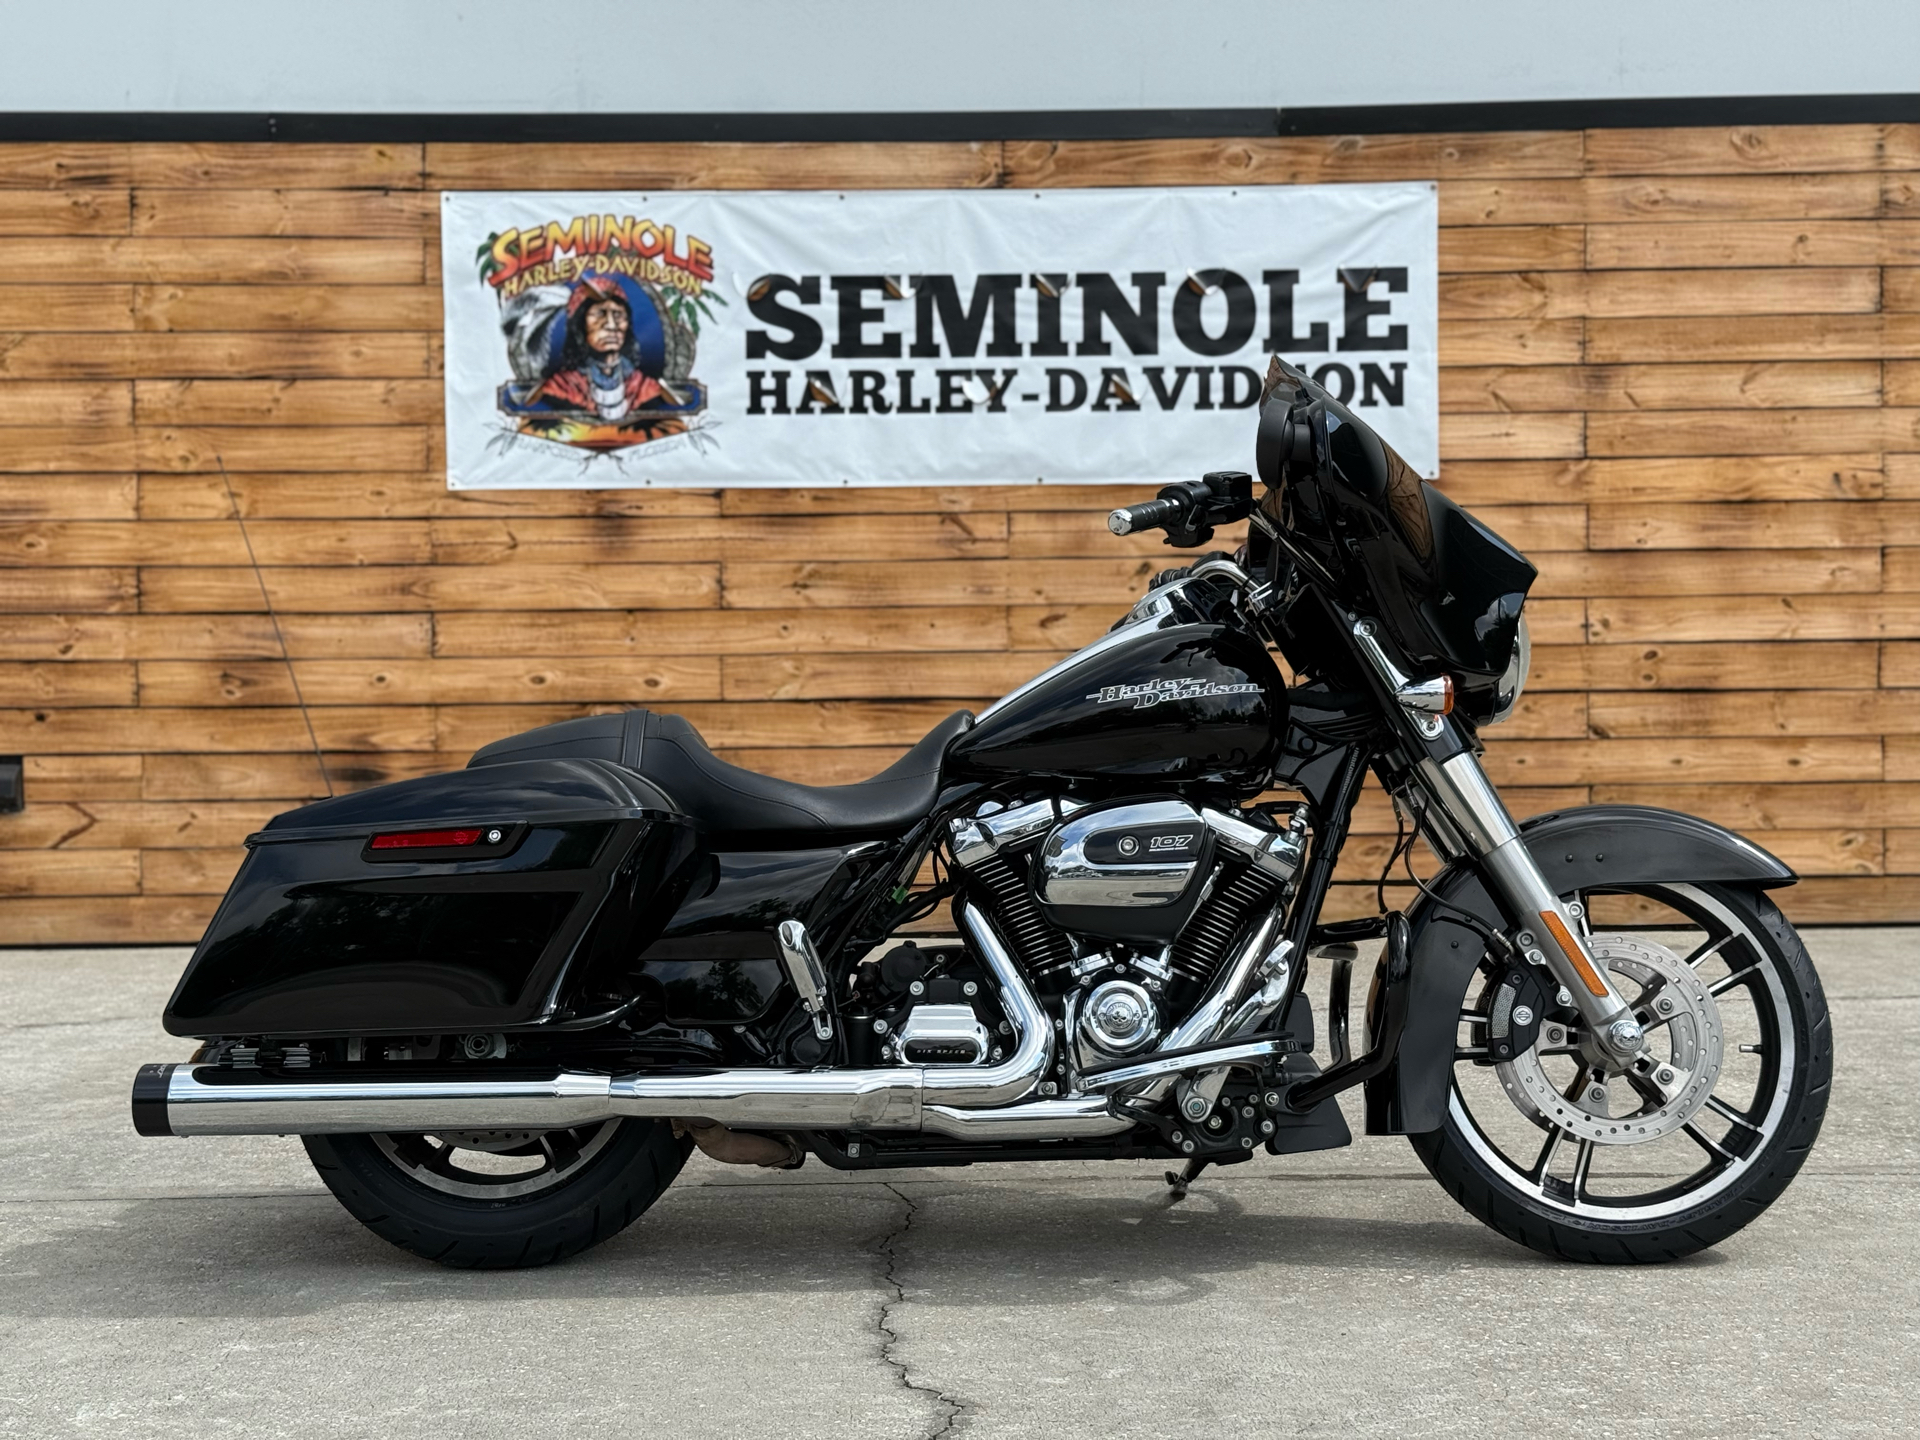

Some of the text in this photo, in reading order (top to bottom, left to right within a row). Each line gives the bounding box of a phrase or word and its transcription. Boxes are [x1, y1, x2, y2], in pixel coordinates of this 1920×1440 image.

[488, 214, 714, 286] SEMINOLE
[503, 253, 703, 297] HARLEY-DAVIDSON
[746, 266, 1409, 361] SEMINOLE
[746, 361, 1408, 415] HARLEY-DAVIDON
[1086, 677, 1207, 704] Harley
[1125, 682, 1265, 710] Davidson
[1150, 835, 1194, 848] 107
